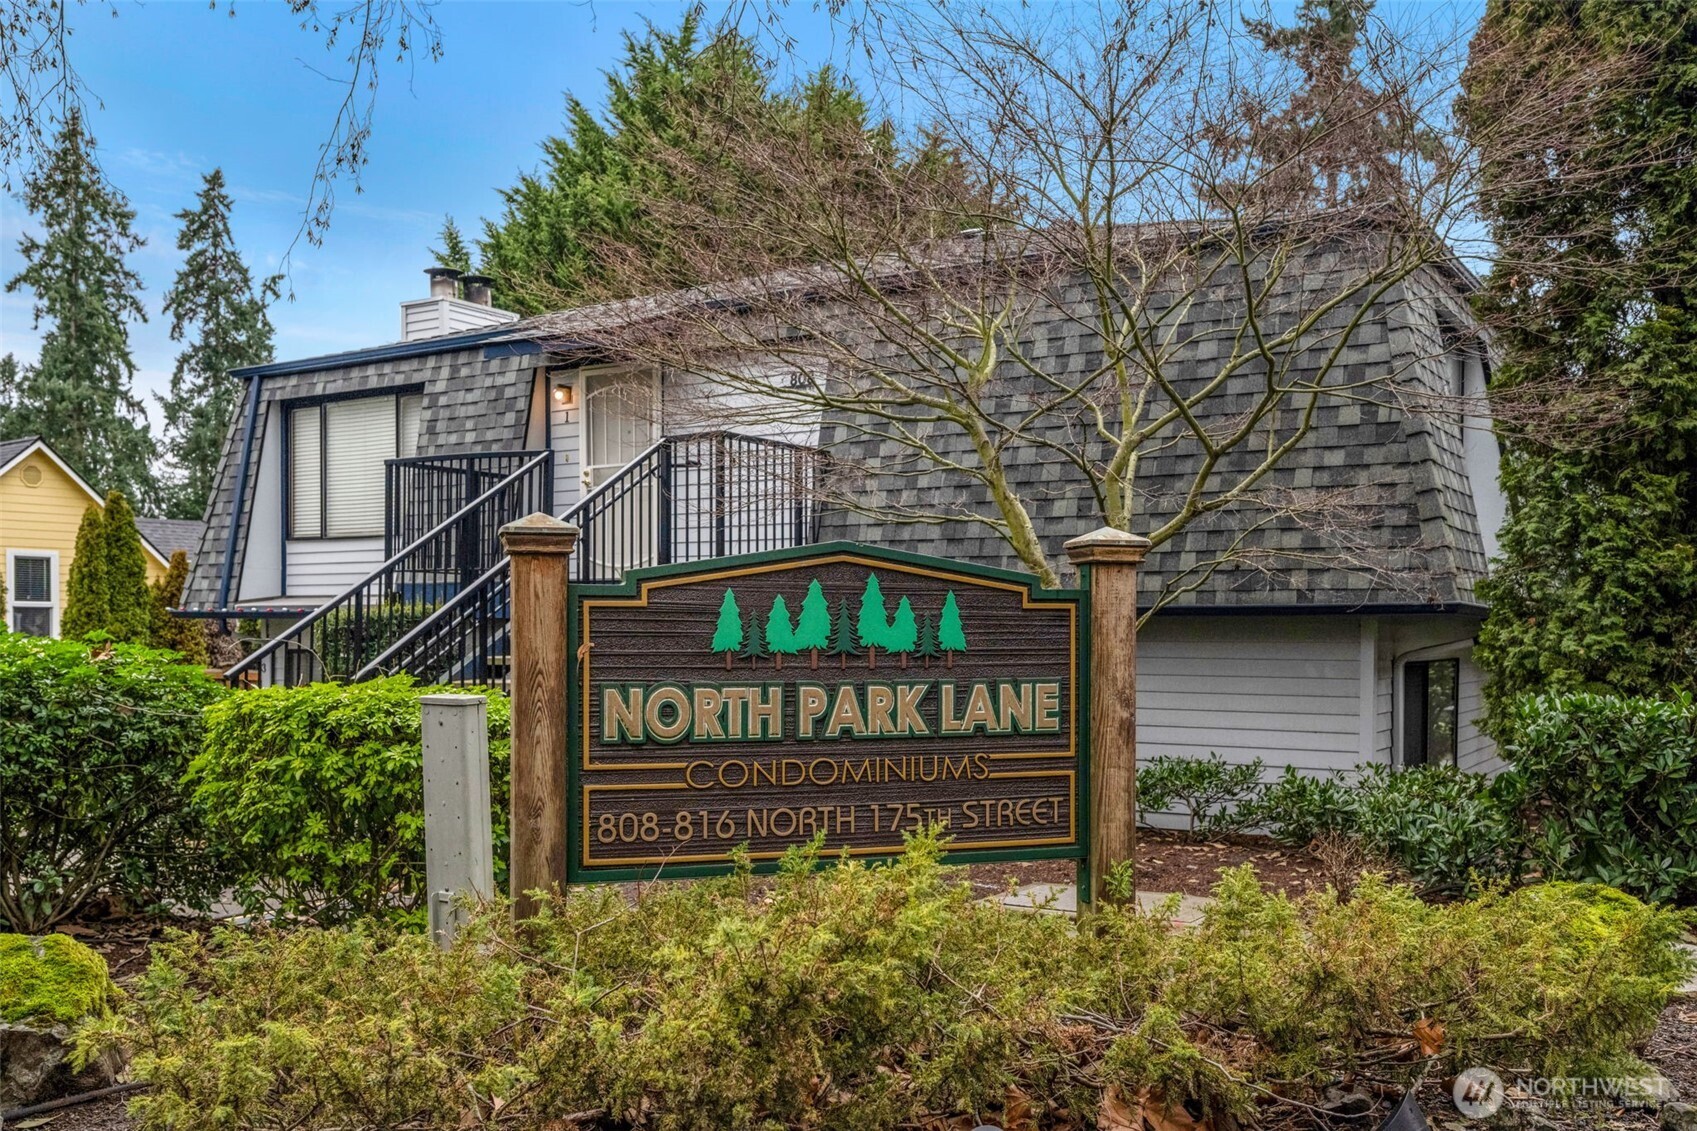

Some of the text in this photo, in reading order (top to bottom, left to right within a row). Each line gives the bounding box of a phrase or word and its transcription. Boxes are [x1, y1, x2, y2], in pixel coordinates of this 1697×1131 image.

[564, 411, 569, 422] 1
[602, 681, 1061, 743] NORTH PARK LANE
[686, 751, 990, 789] CONDOMINIUMS
[597, 810, 736, 844] 808-816
[747, 805, 855, 838] NORTH
[962, 797, 1064, 829] STREET
